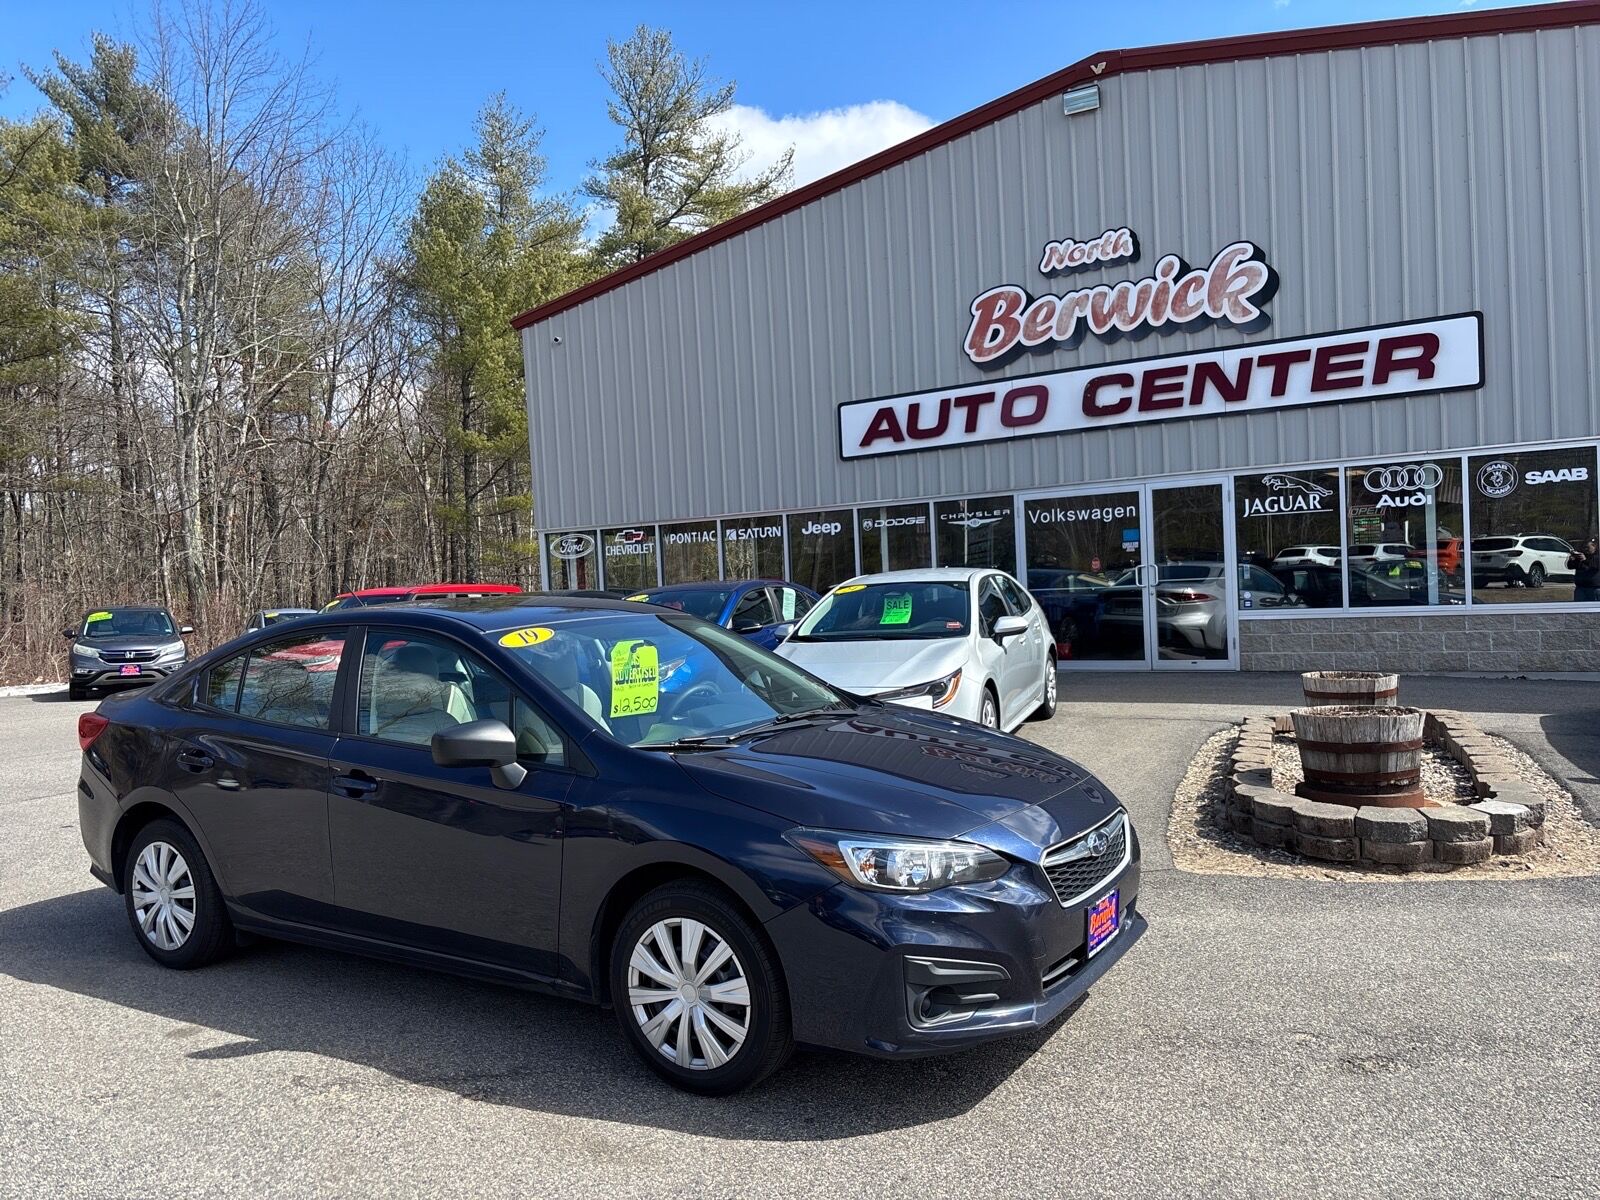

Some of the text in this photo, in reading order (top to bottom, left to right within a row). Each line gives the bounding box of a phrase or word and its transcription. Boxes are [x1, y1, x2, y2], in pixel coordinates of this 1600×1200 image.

[1040, 228, 1134, 273] North
[964, 243, 1269, 362] Berwick
[859, 332, 1441, 447] AUTO CENTER
[1525, 467, 1589, 485] SAAB
[1243, 493, 1322, 518] JAGUAR
[1376, 493, 1432, 508] Audi
[874, 516, 926, 528] DODGE
[940, 509, 1010, 521] CHRYSLER
[1028, 505, 1136, 524] Volkswagen
[738, 526, 782, 540] SATURN
[802, 521, 842, 535] Jeep
[670, 530, 716, 545] PONTIAC
[560, 538, 585, 553] Ford
[605, 543, 654, 556] CHEVROLET
[886, 600, 910, 610] SALE
[518, 629, 539, 644] 19
[613, 696, 657, 714] $12,500
